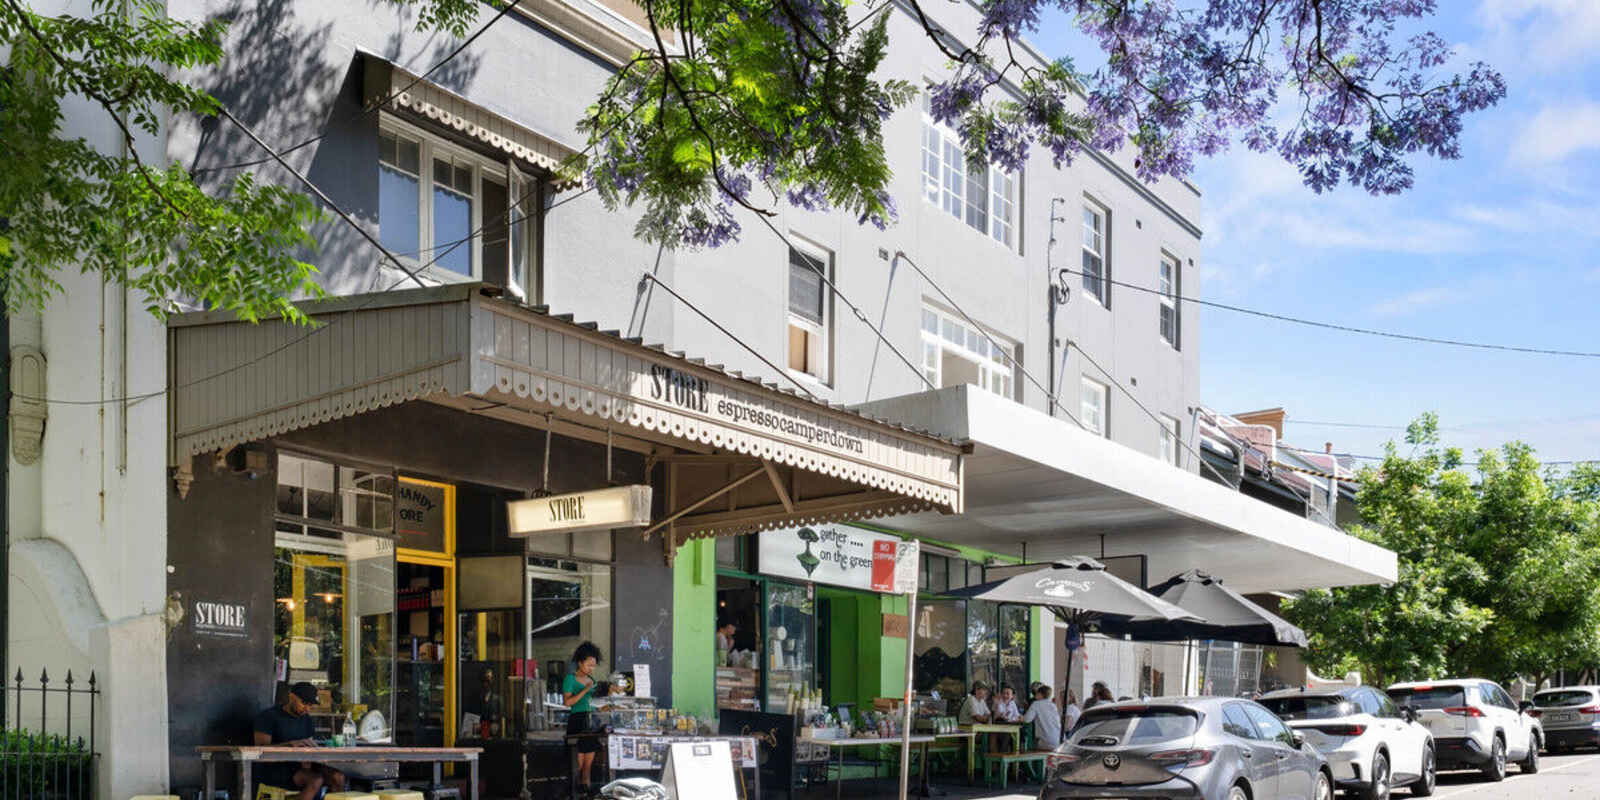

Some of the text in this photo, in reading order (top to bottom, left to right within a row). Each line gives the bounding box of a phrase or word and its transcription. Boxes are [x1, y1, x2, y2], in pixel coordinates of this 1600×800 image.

[651, 363, 863, 453] STORE espressocamperdown
[399, 508, 424, 522] ORE
[548, 496, 585, 521] STORE
[820, 527, 848, 548] gather
[820, 550, 832, 561] on
[833, 550, 848, 570] the
[195, 601, 246, 627] STORE
